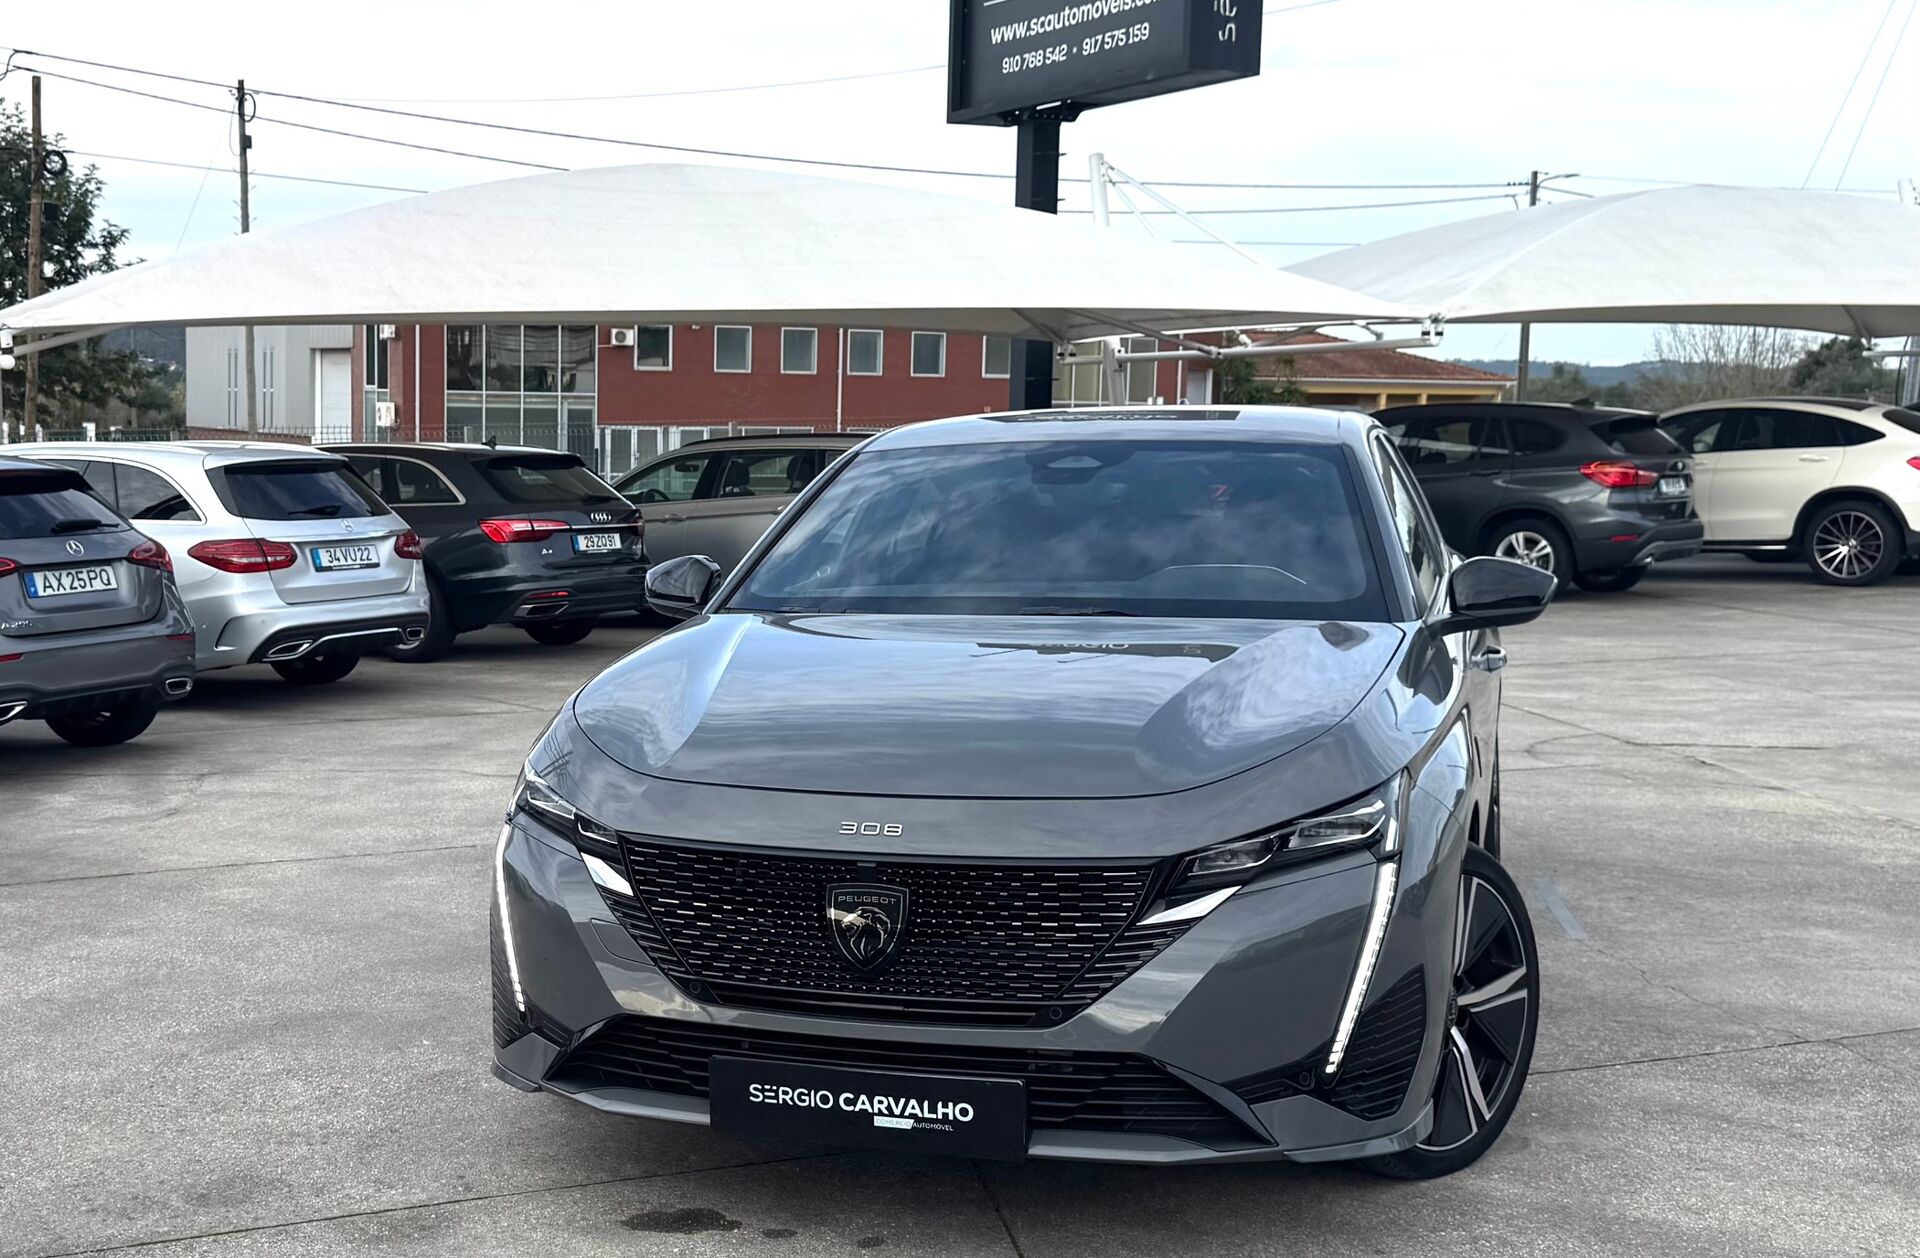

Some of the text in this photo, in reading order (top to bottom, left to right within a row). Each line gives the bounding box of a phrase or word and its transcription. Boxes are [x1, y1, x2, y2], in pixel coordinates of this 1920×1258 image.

[990, 0, 1161, 44] www.scautomoveis.
[1002, 22, 1150, 74] 910 768 542 917 575 159
[325, 547, 373, 564] 34VU22
[42, 567, 112, 594] AX25PQ
[839, 821, 903, 836] 308
[838, 895, 896, 905] PEUGEOT
[839, 1092, 975, 1122] CARVALHO
